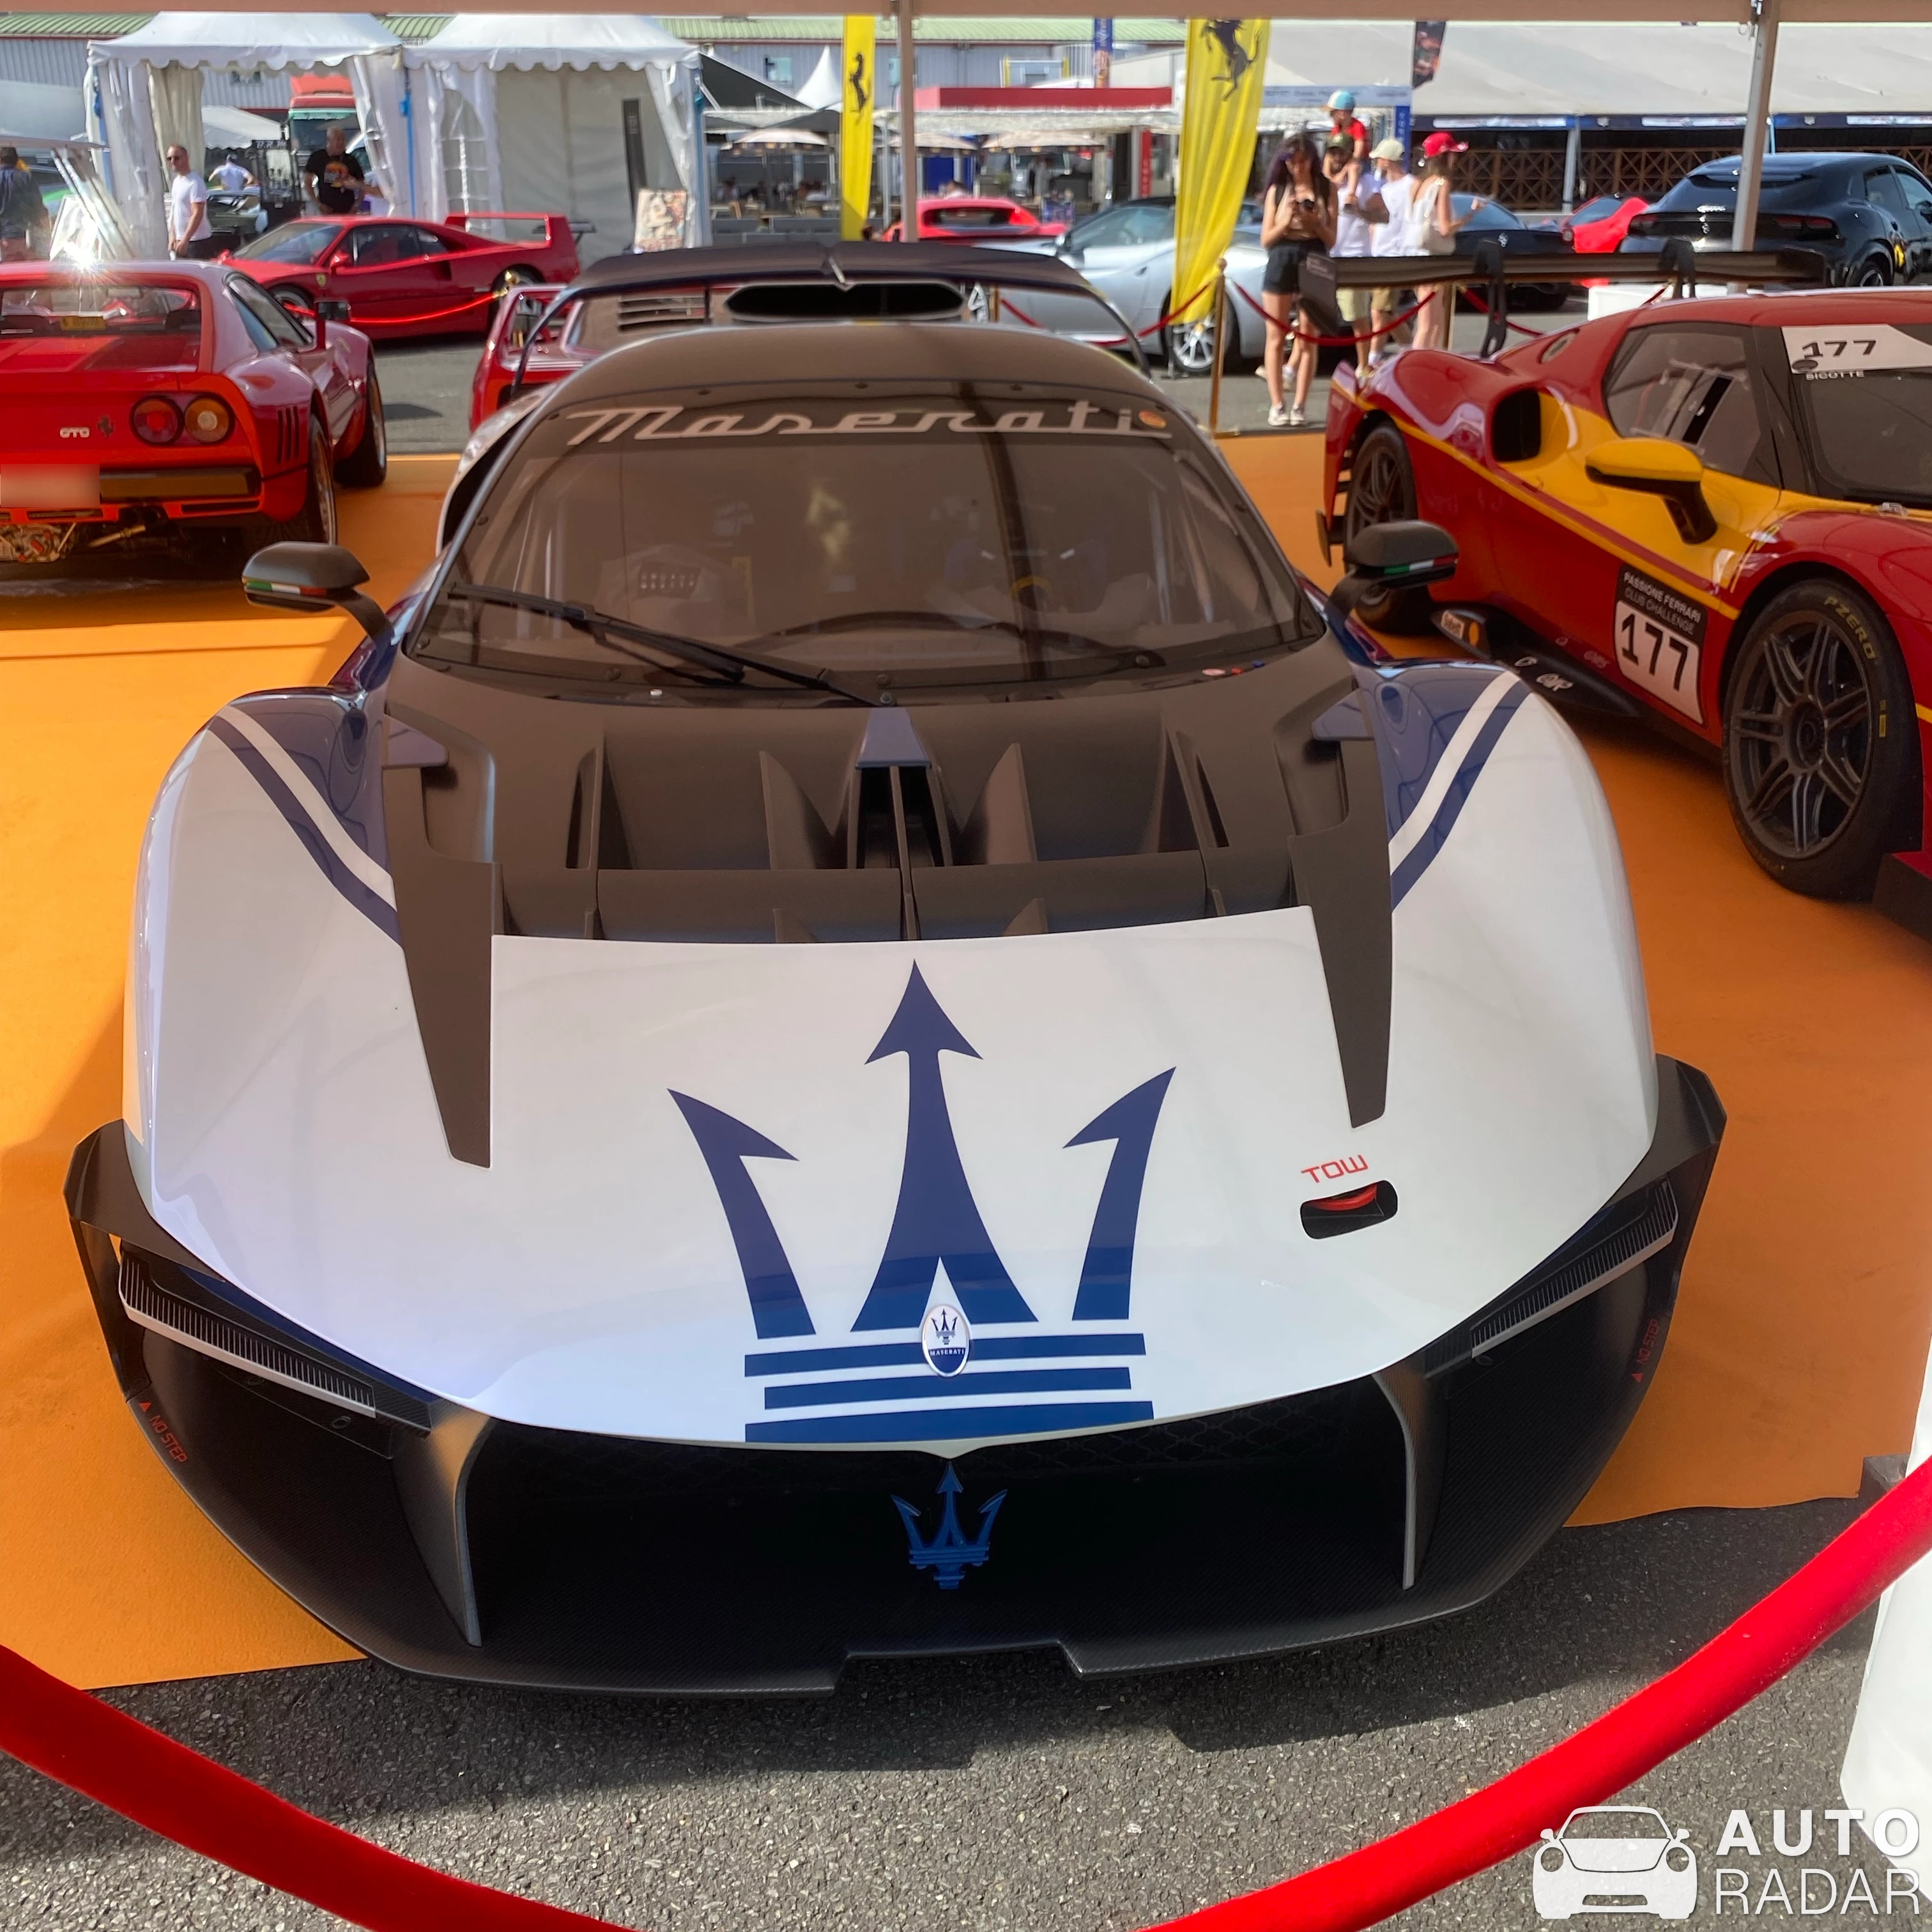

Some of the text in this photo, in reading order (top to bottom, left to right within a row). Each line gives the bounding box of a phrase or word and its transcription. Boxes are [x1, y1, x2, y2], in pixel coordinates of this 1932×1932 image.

[1802, 339, 1876, 360] 177
[59, 427, 90, 438] GTO
[565, 400, 1172, 446] Maserati
[1623, 571, 1702, 624] PASSIONE FERRARI
[1623, 586, 1696, 636] CLUB CHALLENGE
[1620, 613, 1689, 693] 177
[1301, 1154, 1368, 1183] TOW
[929, 1348, 965, 1356] MASERATI
[150, 1414, 188, 1462] NO STEP
